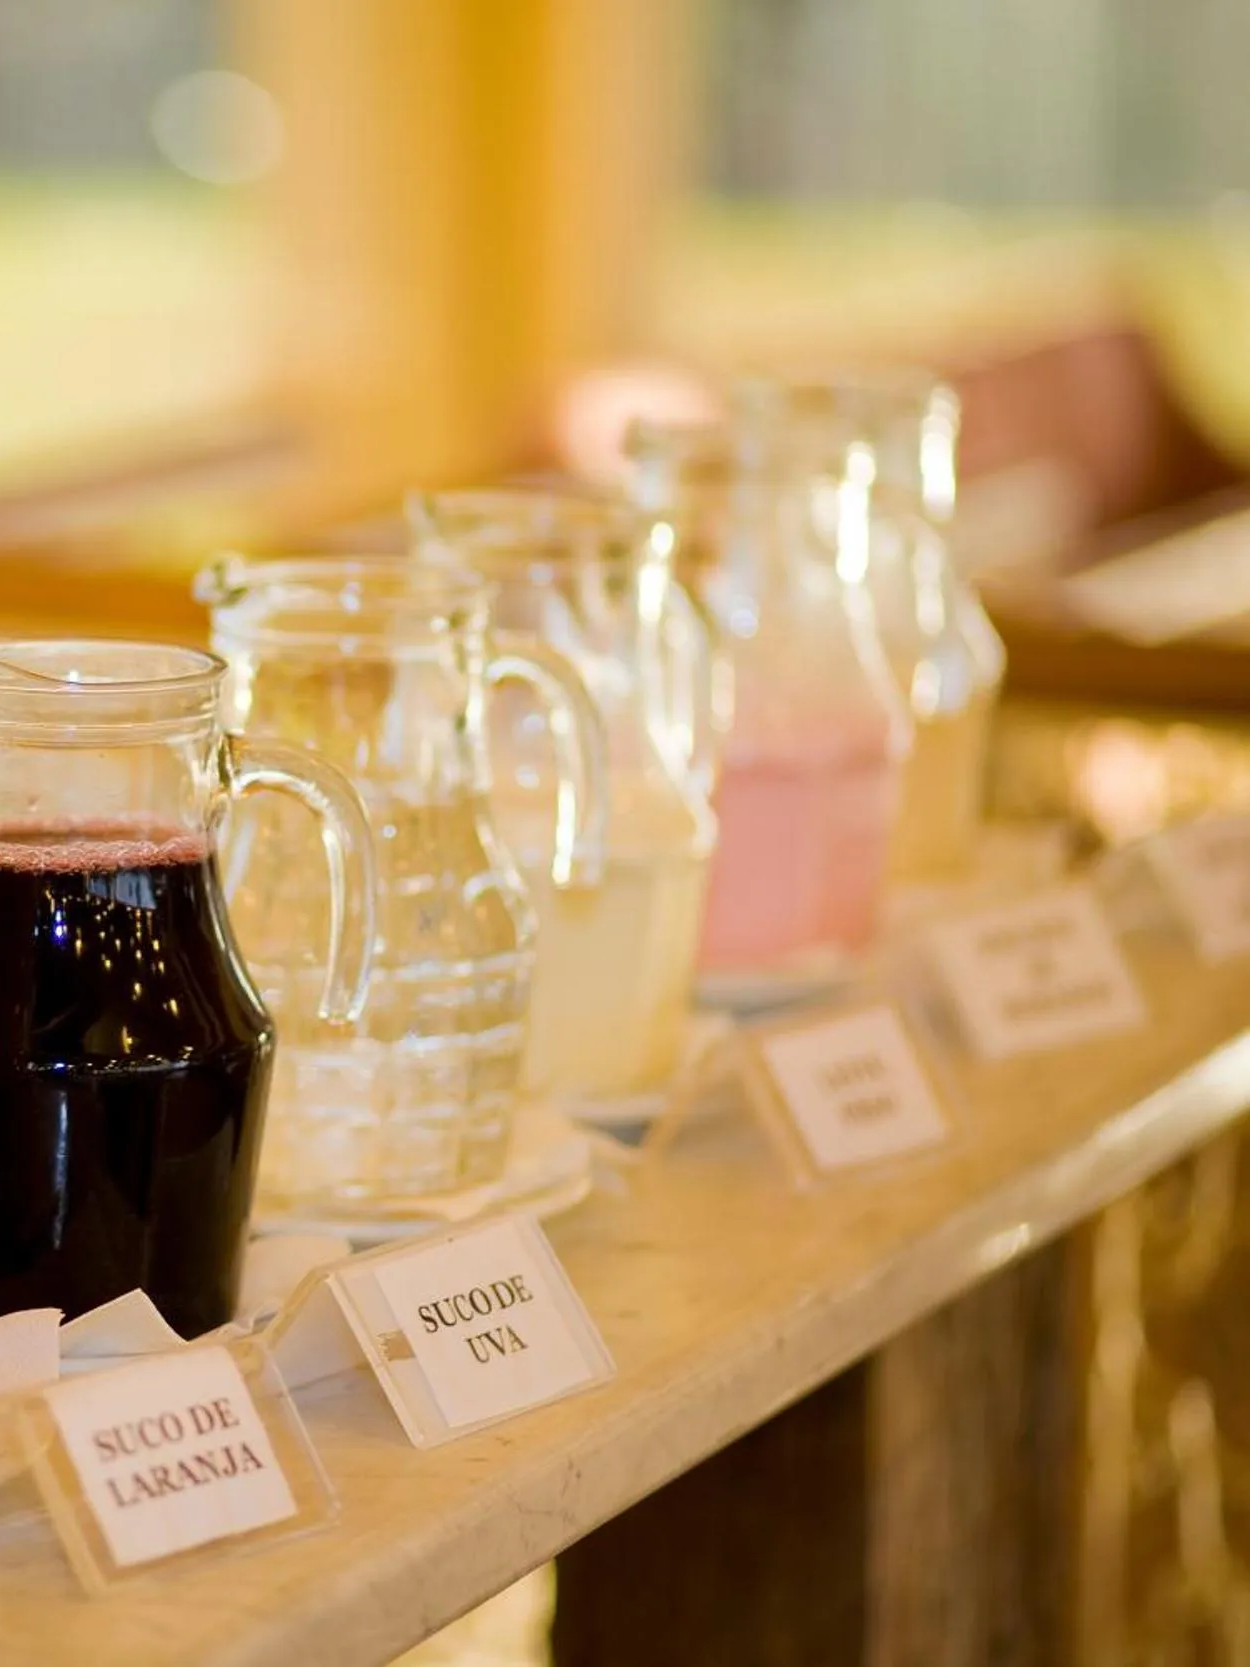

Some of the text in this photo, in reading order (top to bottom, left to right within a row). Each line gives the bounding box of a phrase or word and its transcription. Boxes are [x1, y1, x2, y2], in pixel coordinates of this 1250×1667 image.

[417, 1274, 534, 1333] SUCO DE
[466, 1324, 528, 1365] UVA
[92, 1397, 240, 1463] SUCO DE
[106, 1441, 265, 1508] LARANJA
